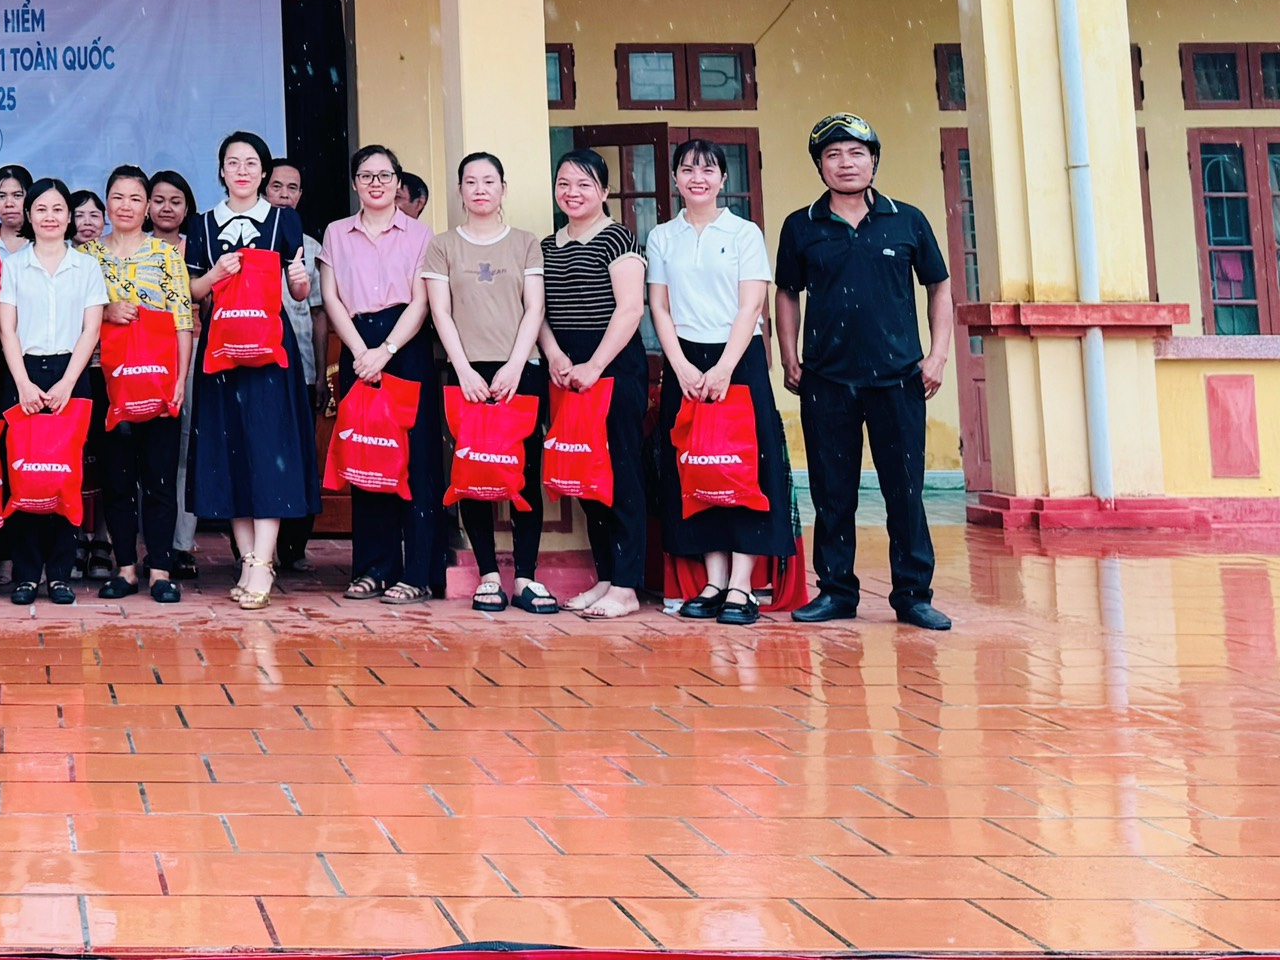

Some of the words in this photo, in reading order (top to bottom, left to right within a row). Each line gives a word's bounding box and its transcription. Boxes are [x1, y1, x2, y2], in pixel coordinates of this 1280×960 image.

[4, 0, 45, 33] HIỂM
[0, 48, 6, 72] 1
[10, 41, 57, 71] TOÀN
[62, 36, 115, 71] QUỐC
[221, 309, 268, 318] HONDA
[123, 365, 168, 375] HONDA
[469, 452, 519, 464] HONDA
[688, 455, 743, 465] HONDA
[22, 463, 72, 472] HONDA
